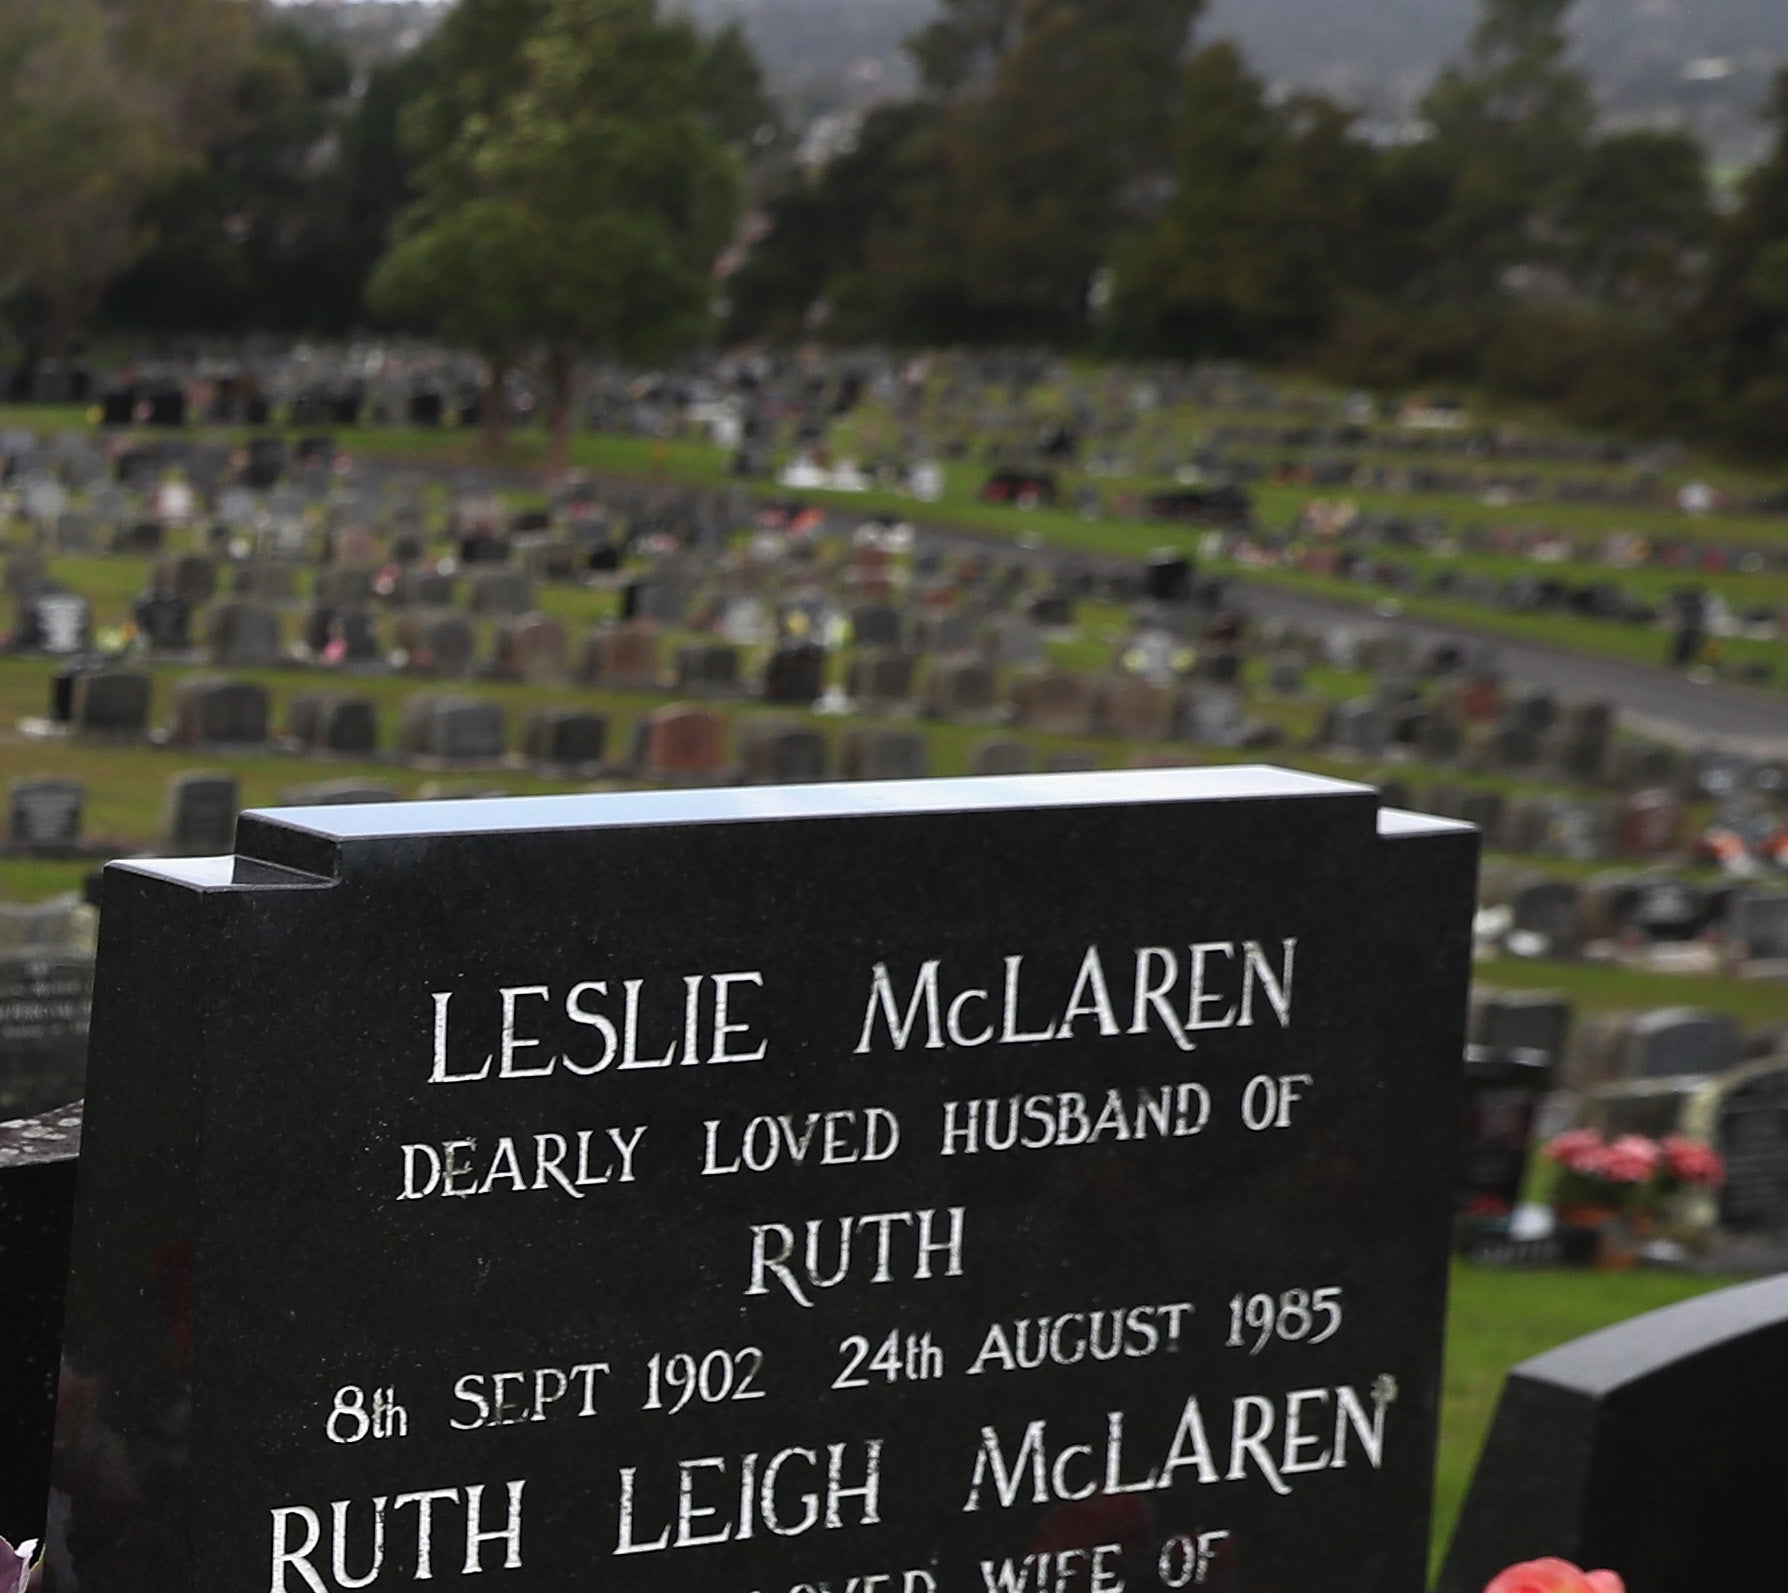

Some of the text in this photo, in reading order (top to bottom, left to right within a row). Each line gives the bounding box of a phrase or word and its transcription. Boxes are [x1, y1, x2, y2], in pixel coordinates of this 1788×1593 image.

[427, 938, 1296, 1083] LESLIE McLAREN
[396, 1074, 1312, 1200] DEARLY LOVED HUSBAND OF
[744, 1207, 965, 1307] RUTH
[327, 1287, 1342, 1443] 8th SEPT 1902 24th AUGUST 1985
[613, 1440, 883, 1554] LEIGH
[963, 1381, 1389, 1511] McLAREN
[1159, 1530, 1229, 1587] OF
